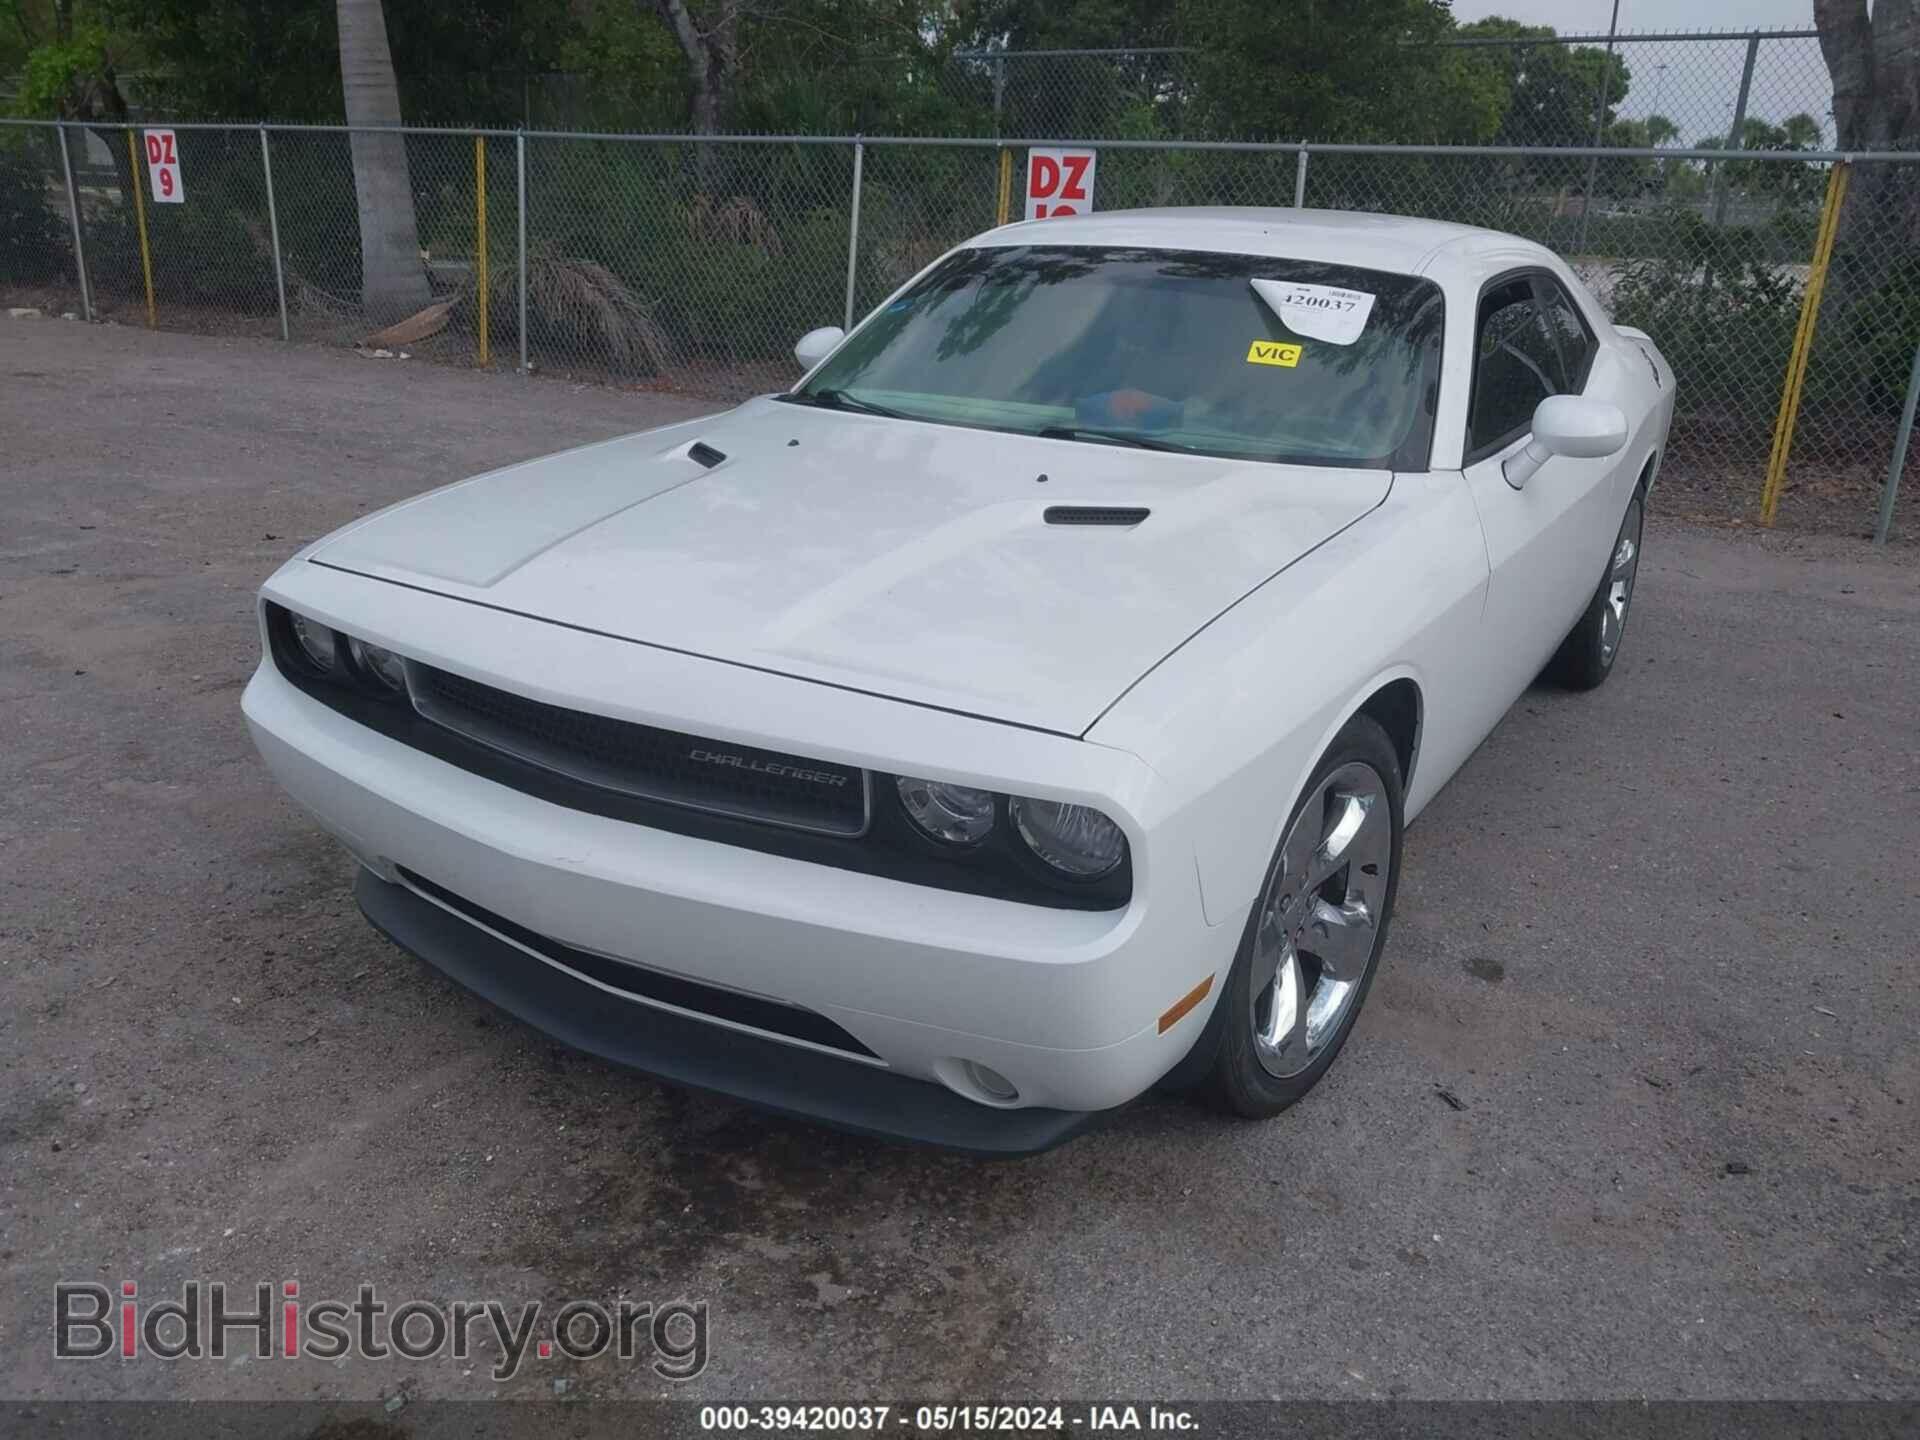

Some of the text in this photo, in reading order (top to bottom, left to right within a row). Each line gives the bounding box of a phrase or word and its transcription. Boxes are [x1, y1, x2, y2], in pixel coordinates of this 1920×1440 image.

[147, 134, 176, 164] DZ
[160, 168, 173, 197] 9
[1029, 155, 1091, 200] DZ
[1255, 346, 1295, 361] VIC
[690, 749, 847, 786] CHALLENGER
